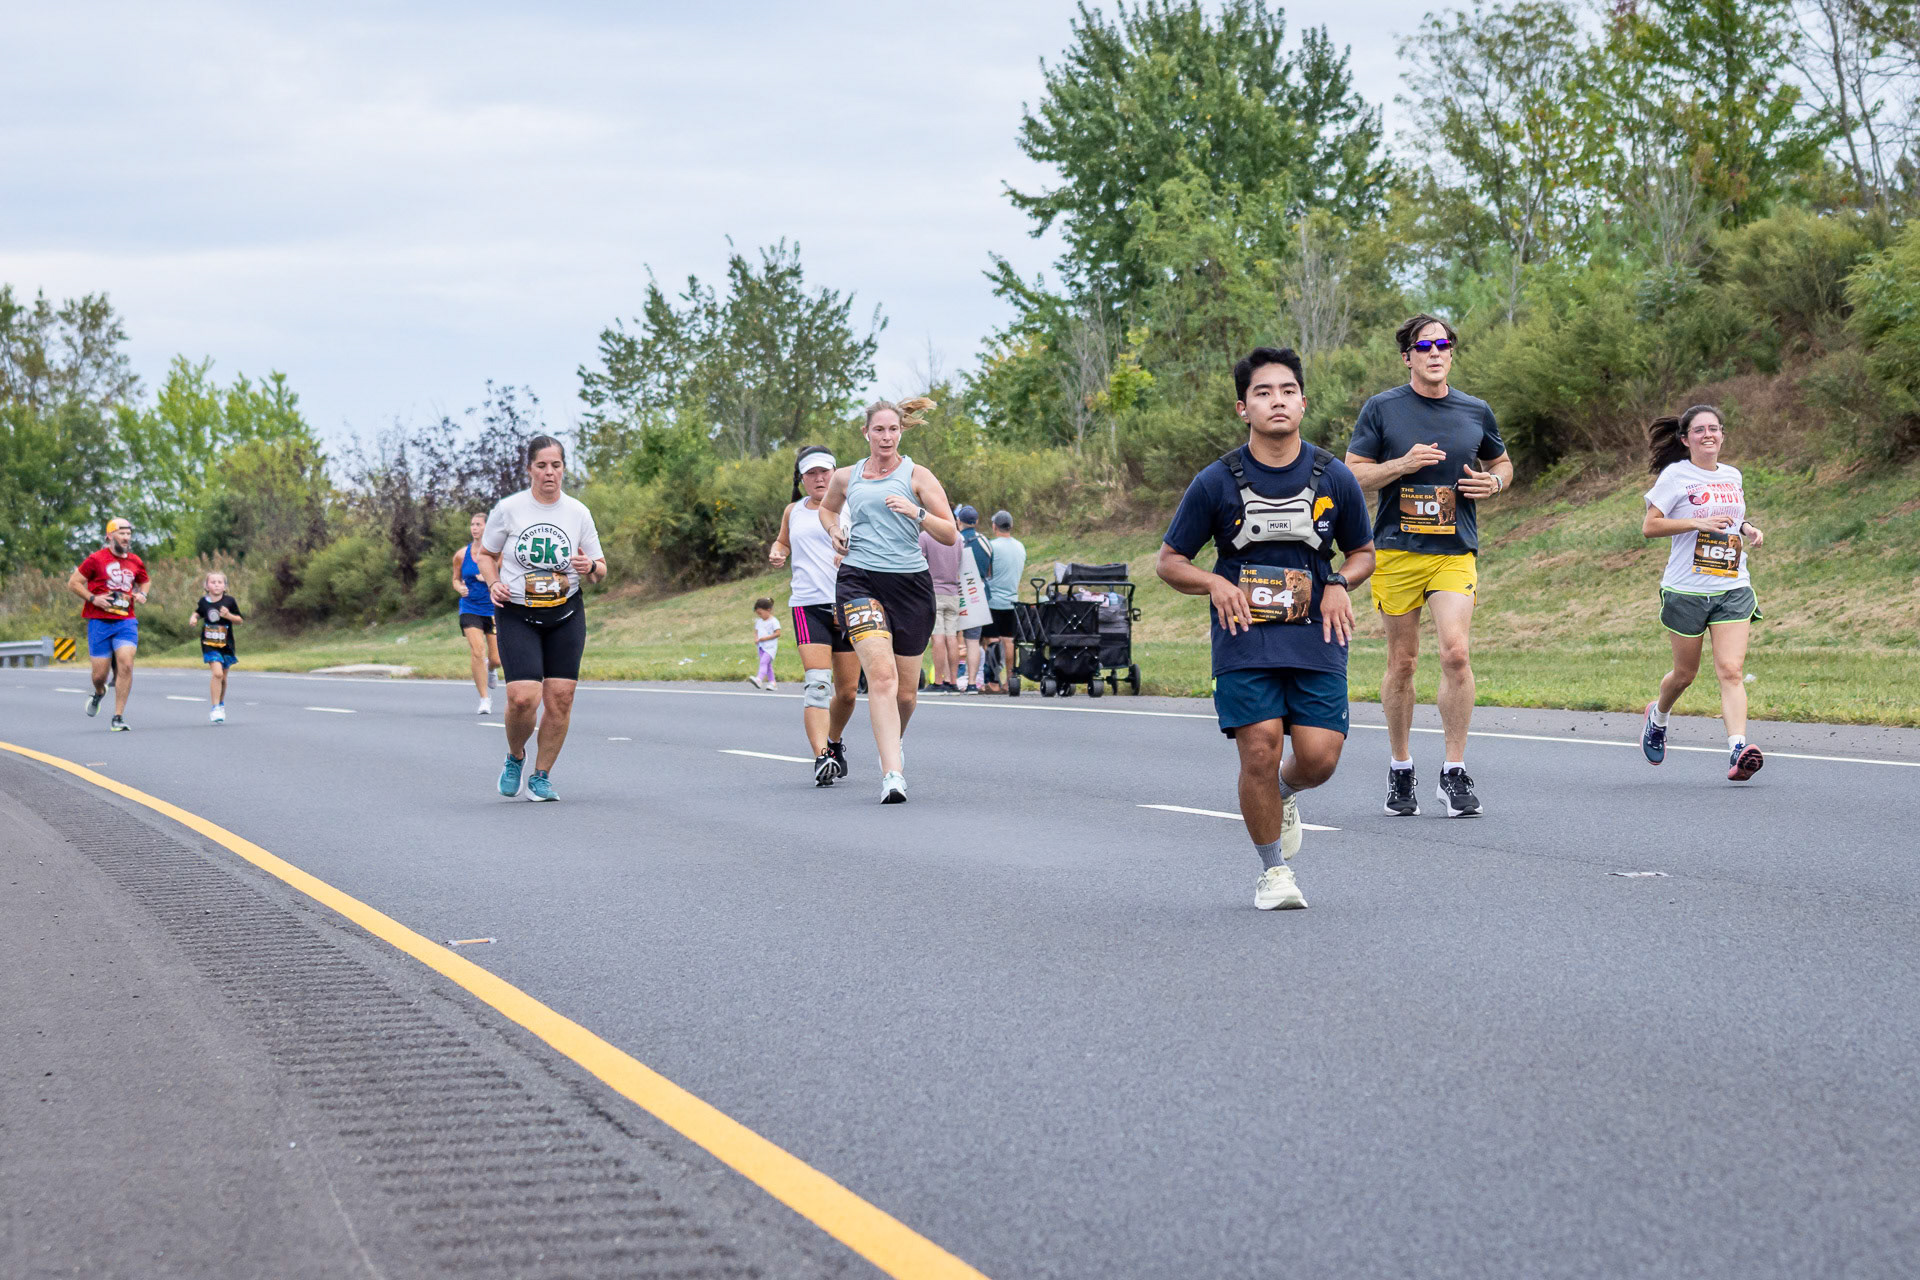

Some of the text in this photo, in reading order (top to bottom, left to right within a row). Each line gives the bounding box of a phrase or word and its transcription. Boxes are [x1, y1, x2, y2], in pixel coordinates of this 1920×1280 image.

[1415, 501, 1440, 515] 10
[522, 526, 566, 544] Morristown
[1702, 545, 1736, 560] 162
[555, 559, 568, 570] Day
[536, 581, 561, 592] 54
[1251, 587, 1294, 607] 64
[849, 611, 883, 626] 273
